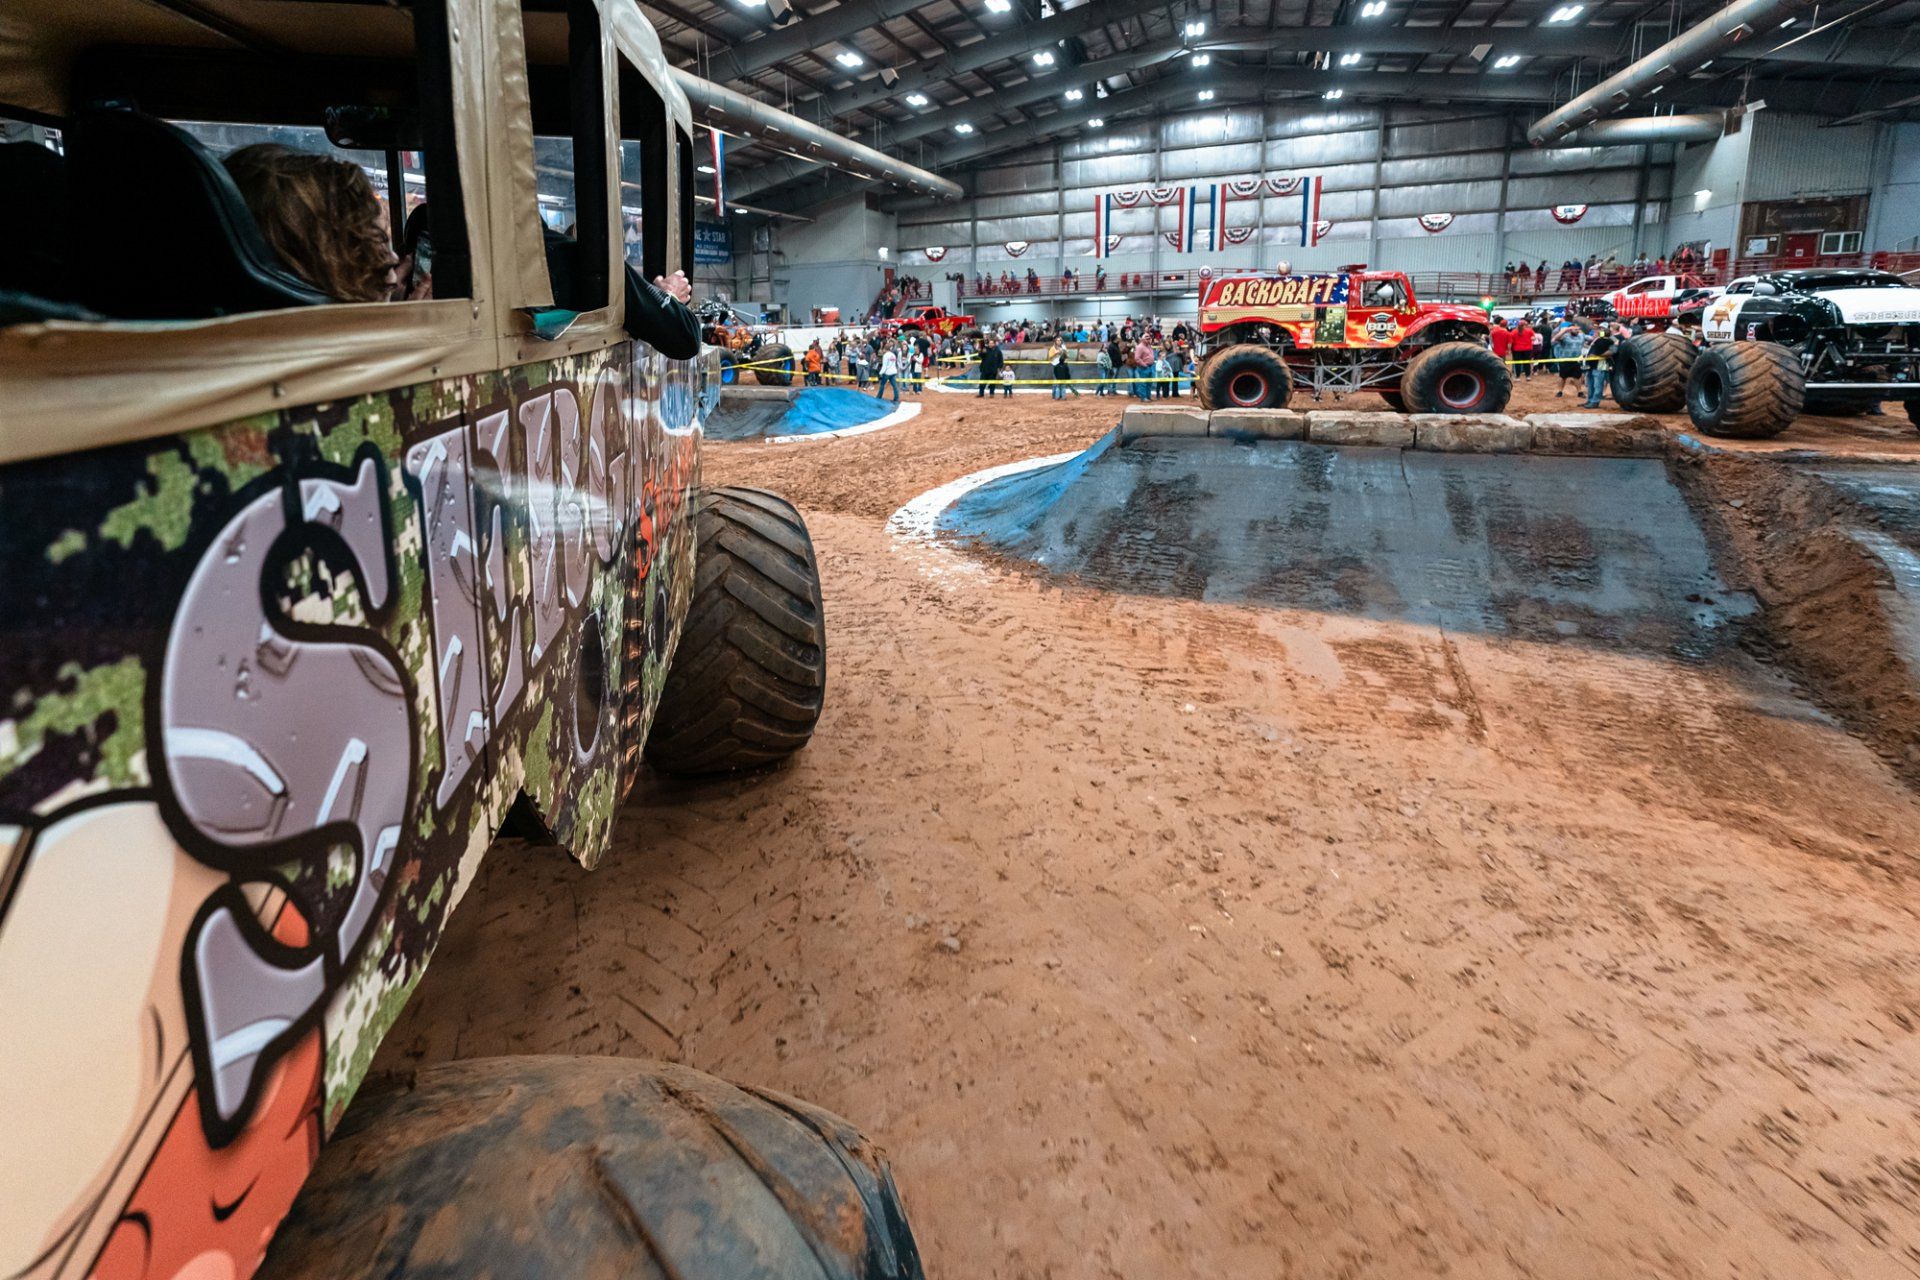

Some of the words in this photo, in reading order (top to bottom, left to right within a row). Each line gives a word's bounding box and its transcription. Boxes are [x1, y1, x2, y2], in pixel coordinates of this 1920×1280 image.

[712, 231, 726, 242] STAR
[1219, 277, 1339, 305] BACKDRAFT
[1706, 330, 1732, 339] SHERIFF
